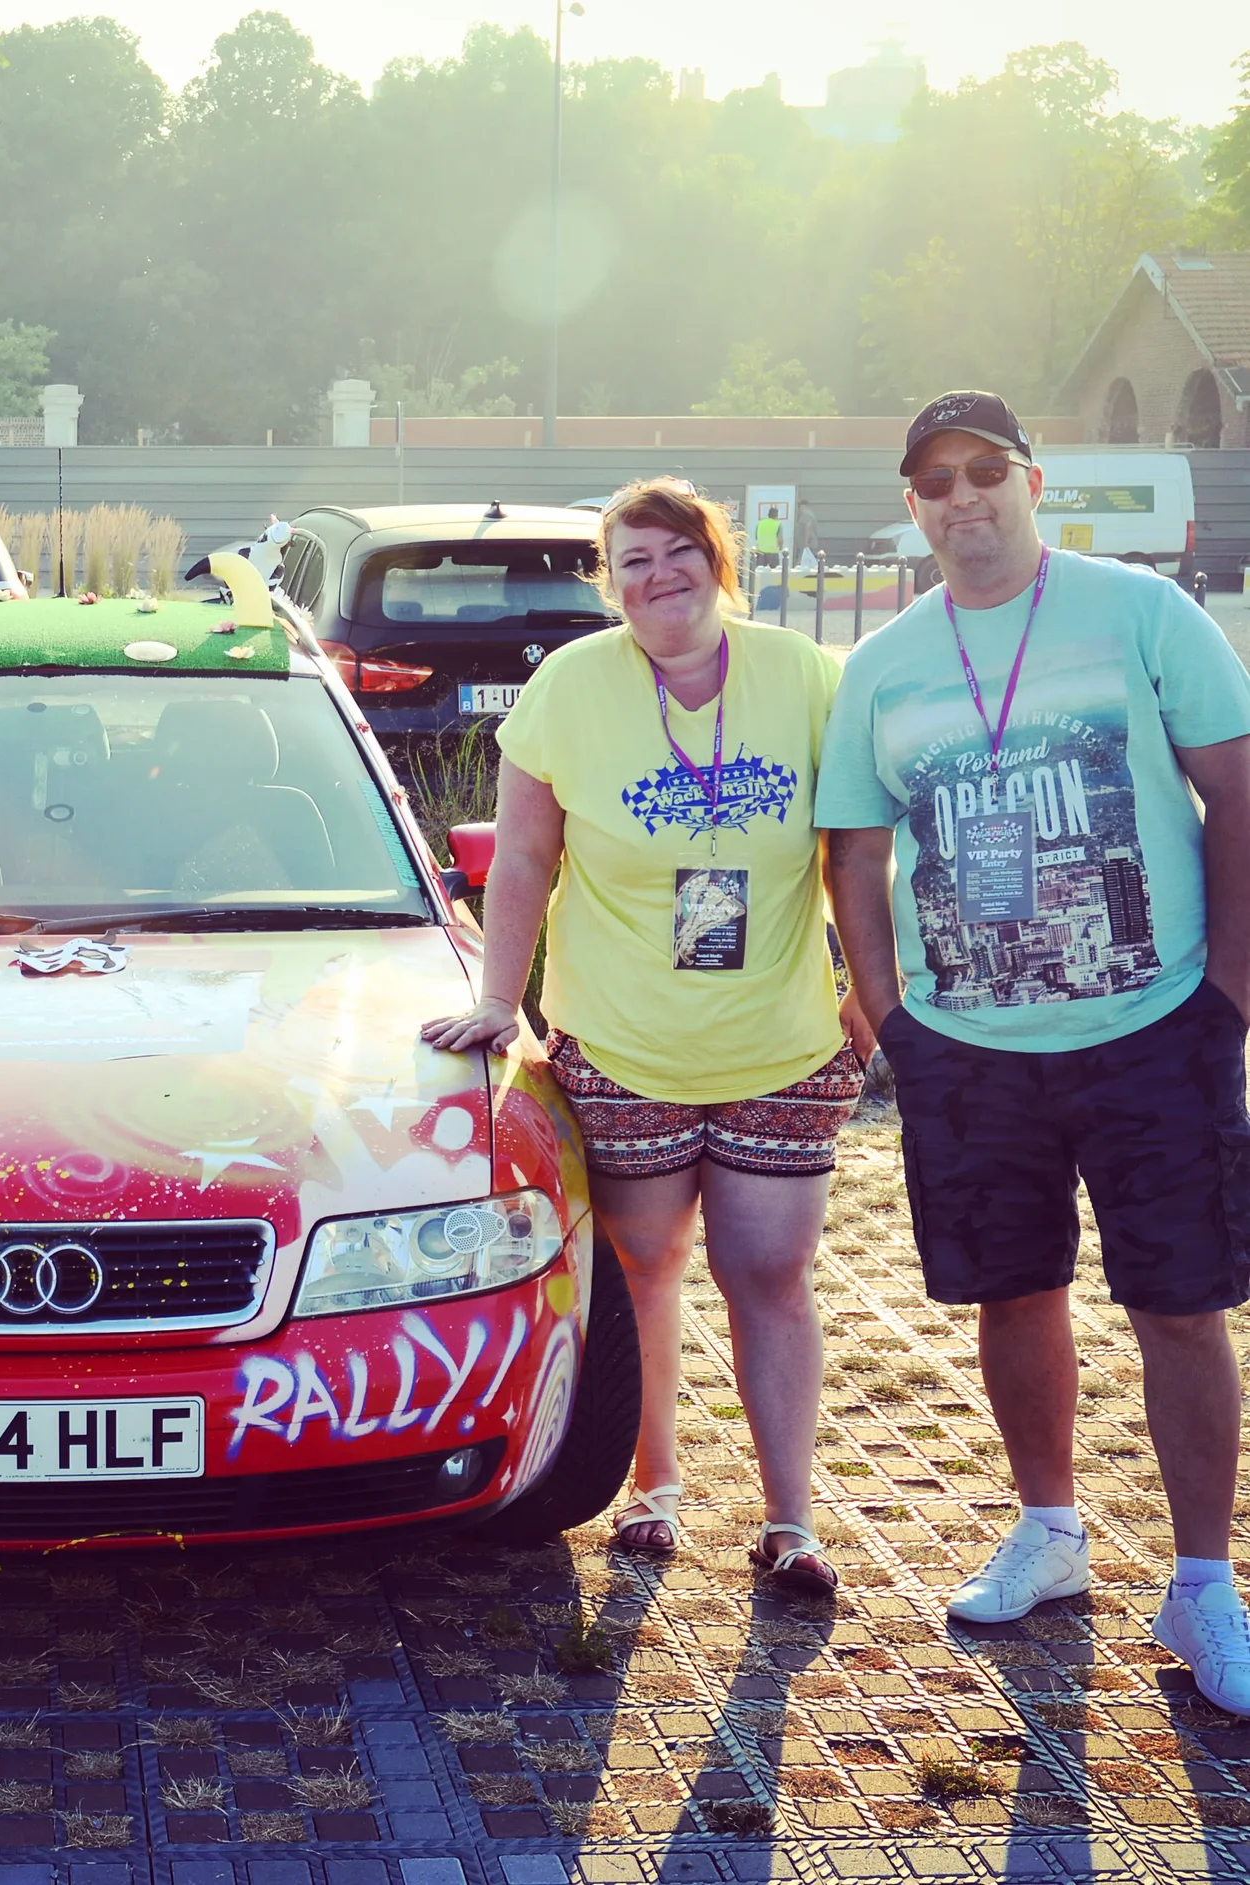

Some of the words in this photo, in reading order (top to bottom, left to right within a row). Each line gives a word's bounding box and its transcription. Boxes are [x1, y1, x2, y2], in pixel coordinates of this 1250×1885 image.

[1043, 490, 1079, 503] DLM
[477, 689, 520, 708] 1-U
[990, 710, 1095, 740] RTHWEST
[914, 723, 977, 774] PACIFIC
[654, 786, 711, 809] Wack
[721, 781, 772, 798] Rally
[967, 850, 988, 860] VIP
[990, 849, 1023, 859] Party
[981, 860, 1008, 868] Entry
[227, 1298, 527, 1454] RALLY!
[58, 1408, 191, 1469] HLF
